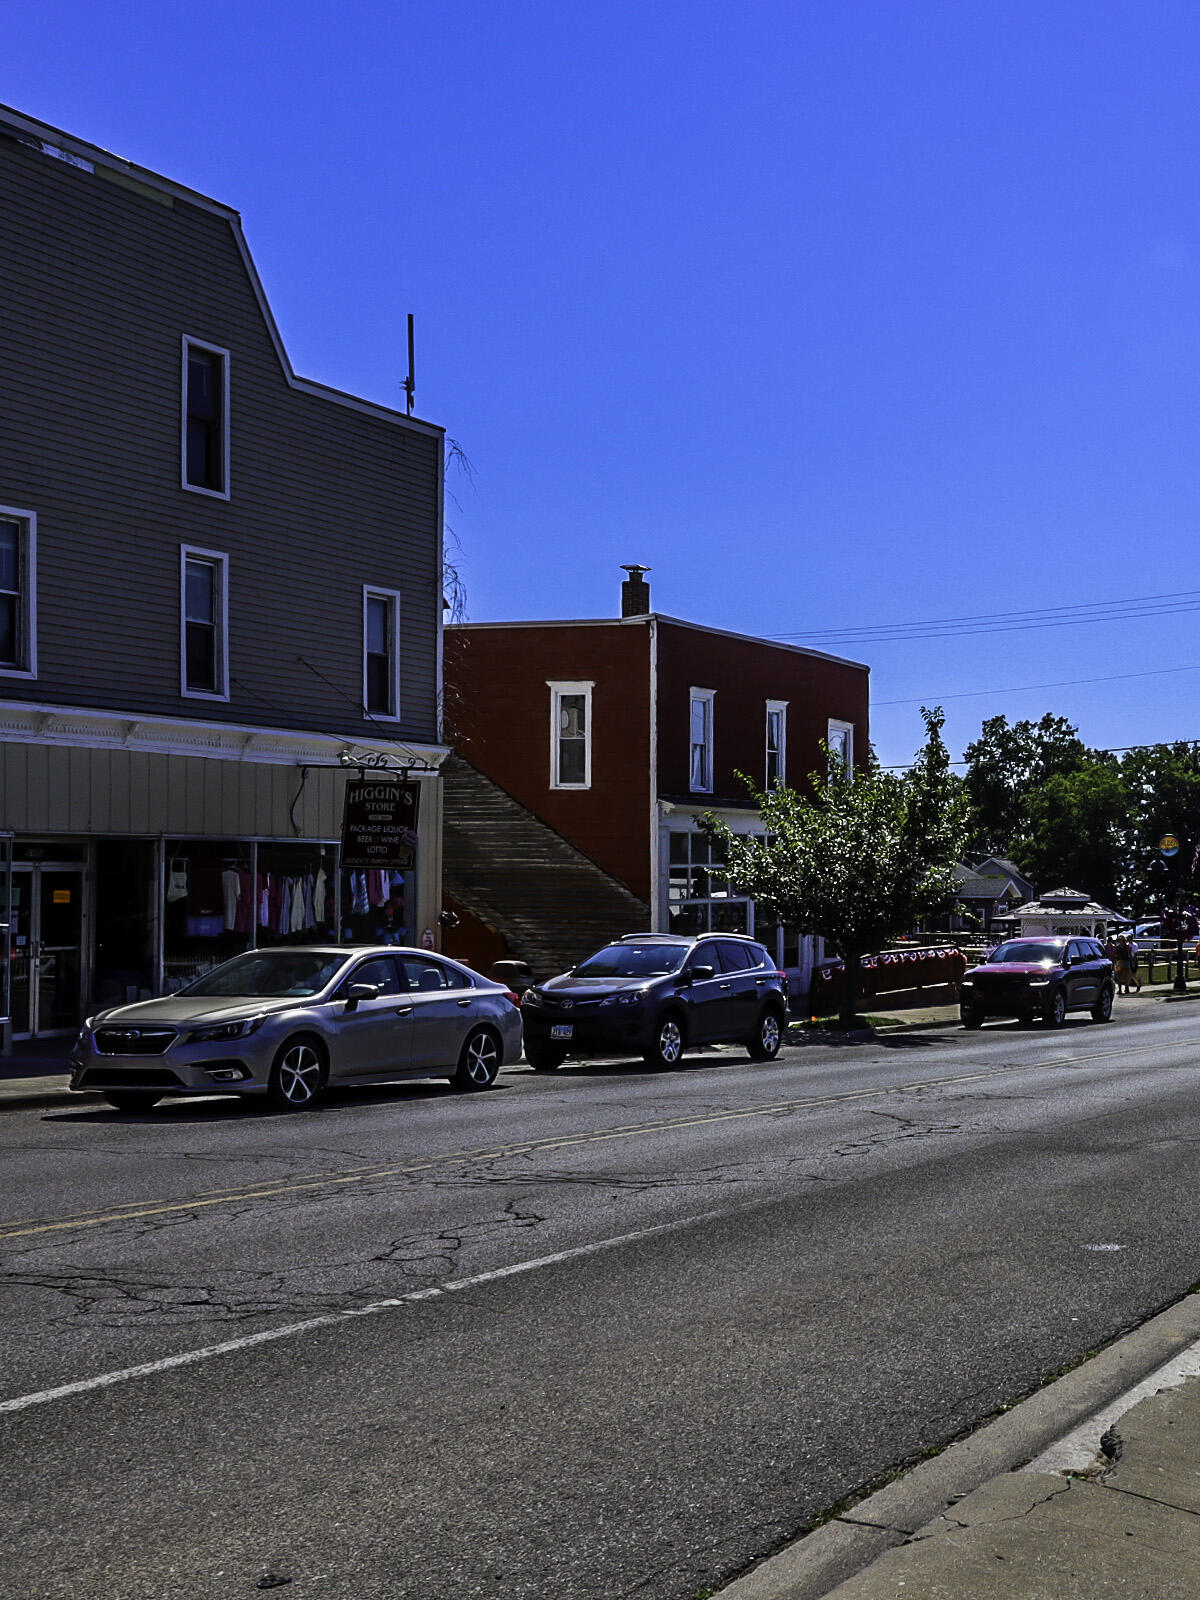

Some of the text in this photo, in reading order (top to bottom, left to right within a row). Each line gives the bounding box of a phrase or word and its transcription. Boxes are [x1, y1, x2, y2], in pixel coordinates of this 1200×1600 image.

[349, 786, 413, 805] HIGGIN'S
[364, 803, 396, 812] STORE
[350, 824, 410, 833] PACKAGE LIQUOR
[357, 835, 401, 844] BEER WINE
[367, 846, 388, 854] LOTTO
